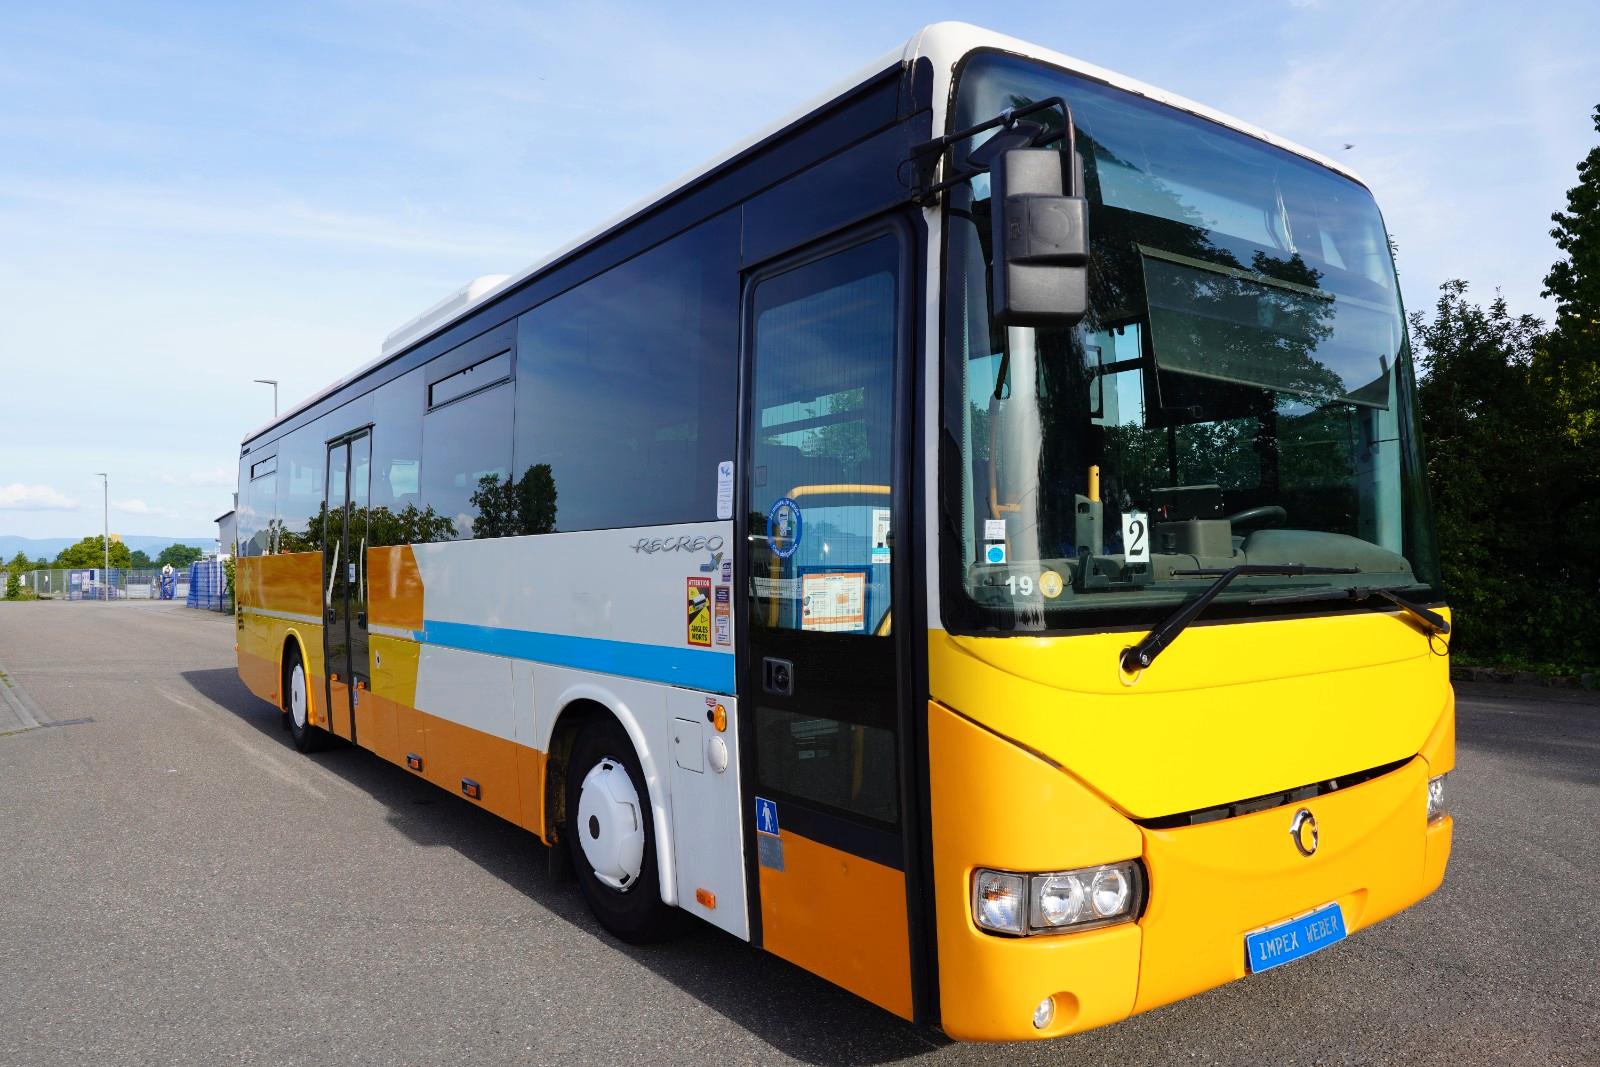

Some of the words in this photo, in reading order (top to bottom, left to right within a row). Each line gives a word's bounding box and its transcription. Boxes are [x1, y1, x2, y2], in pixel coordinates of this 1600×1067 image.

[630, 536, 724, 554] RECREO
[1129, 520, 1144, 556] 2
[1005, 575, 1033, 596] 19
[691, 624, 708, 633] ANGLES
[691, 633, 708, 641] MORTS
[1258, 931, 1300, 961] IMPEX
[1304, 915, 1339, 944] WEBER
